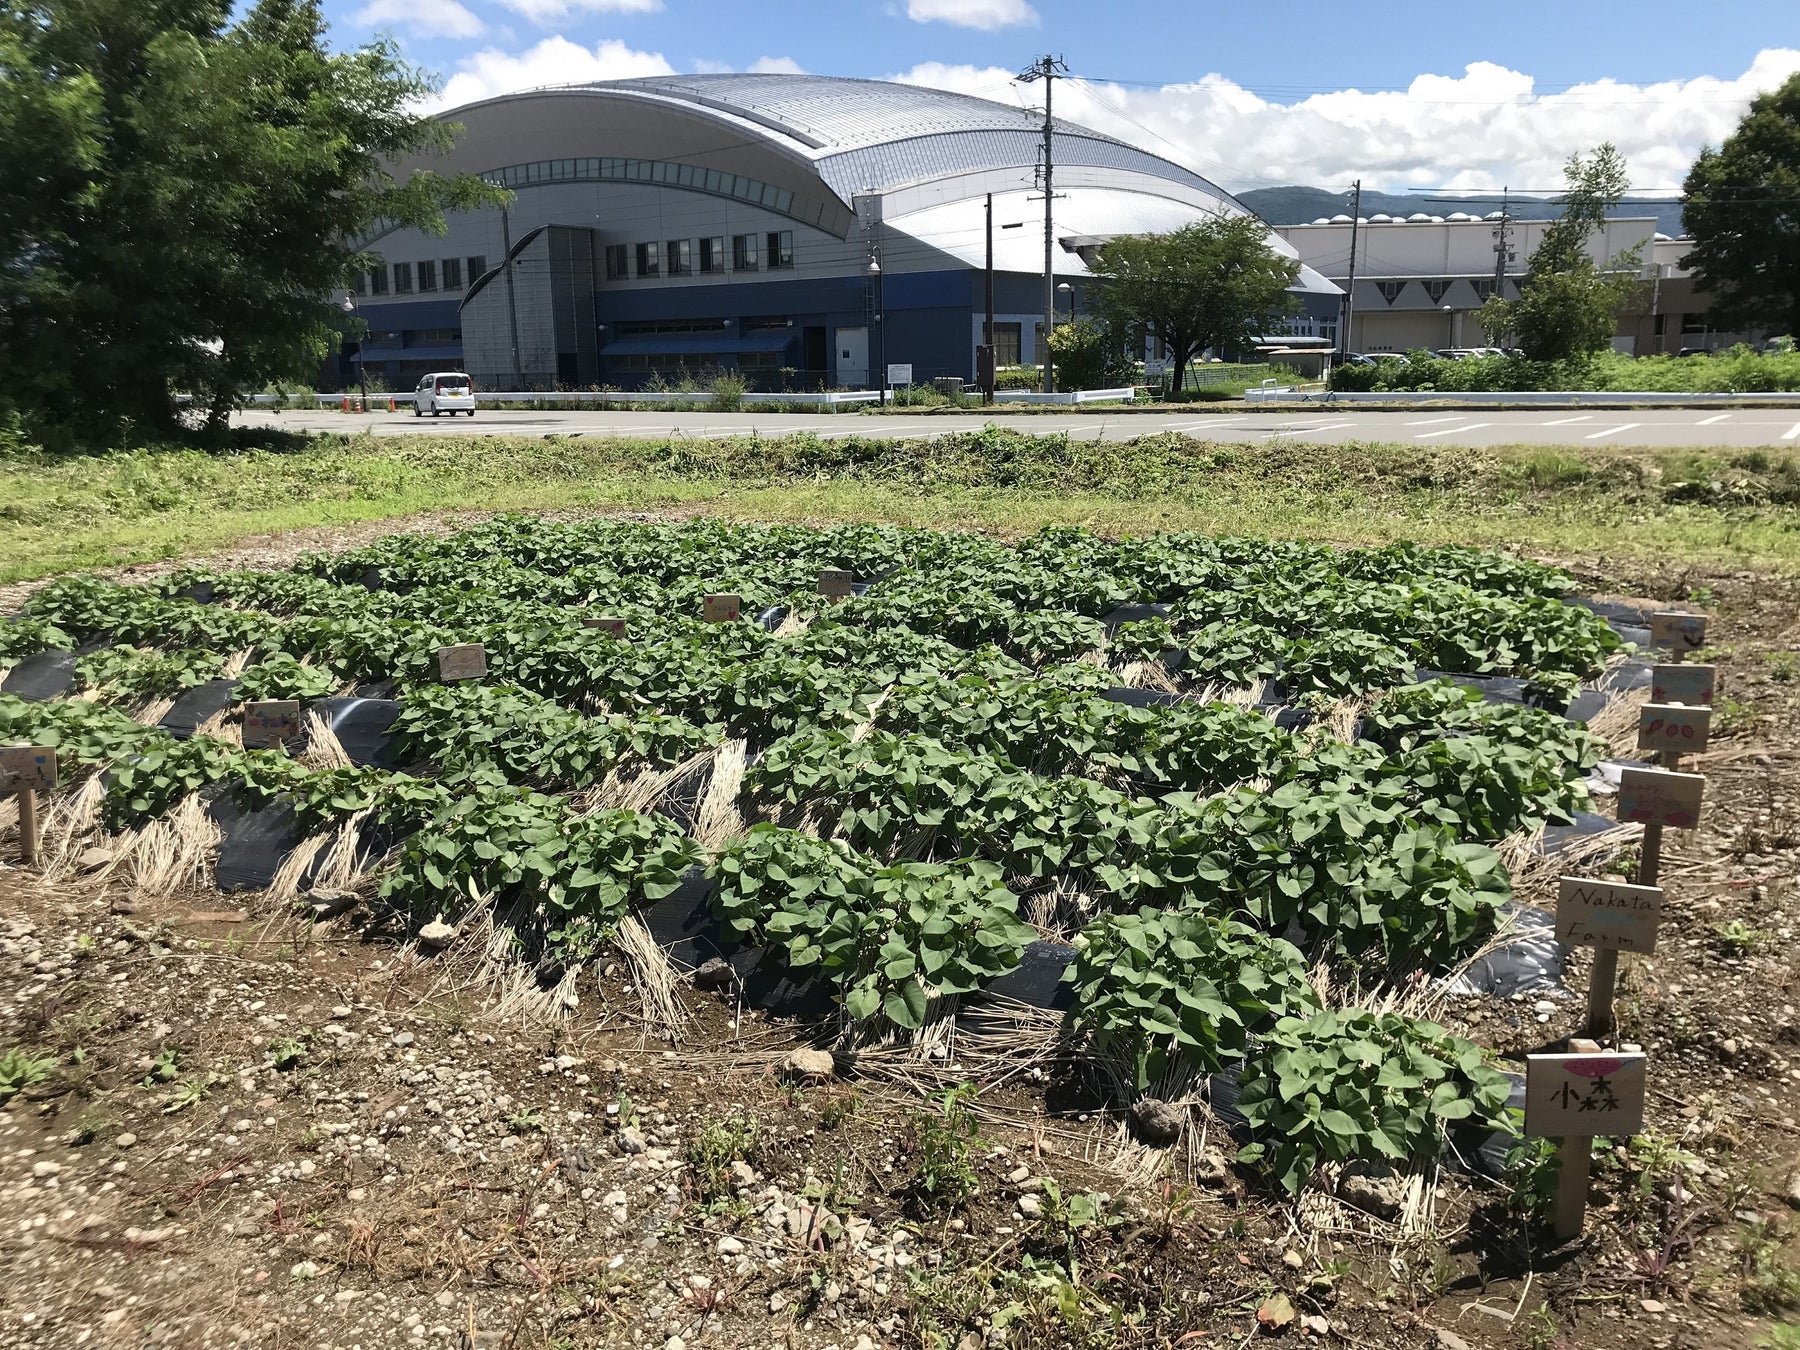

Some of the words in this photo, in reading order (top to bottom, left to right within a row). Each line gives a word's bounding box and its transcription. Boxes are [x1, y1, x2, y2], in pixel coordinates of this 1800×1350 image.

[1568, 887, 1655, 911] Nakata
[1566, 922, 1634, 946] Farm
[1550, 1075, 1620, 1112] 小森
